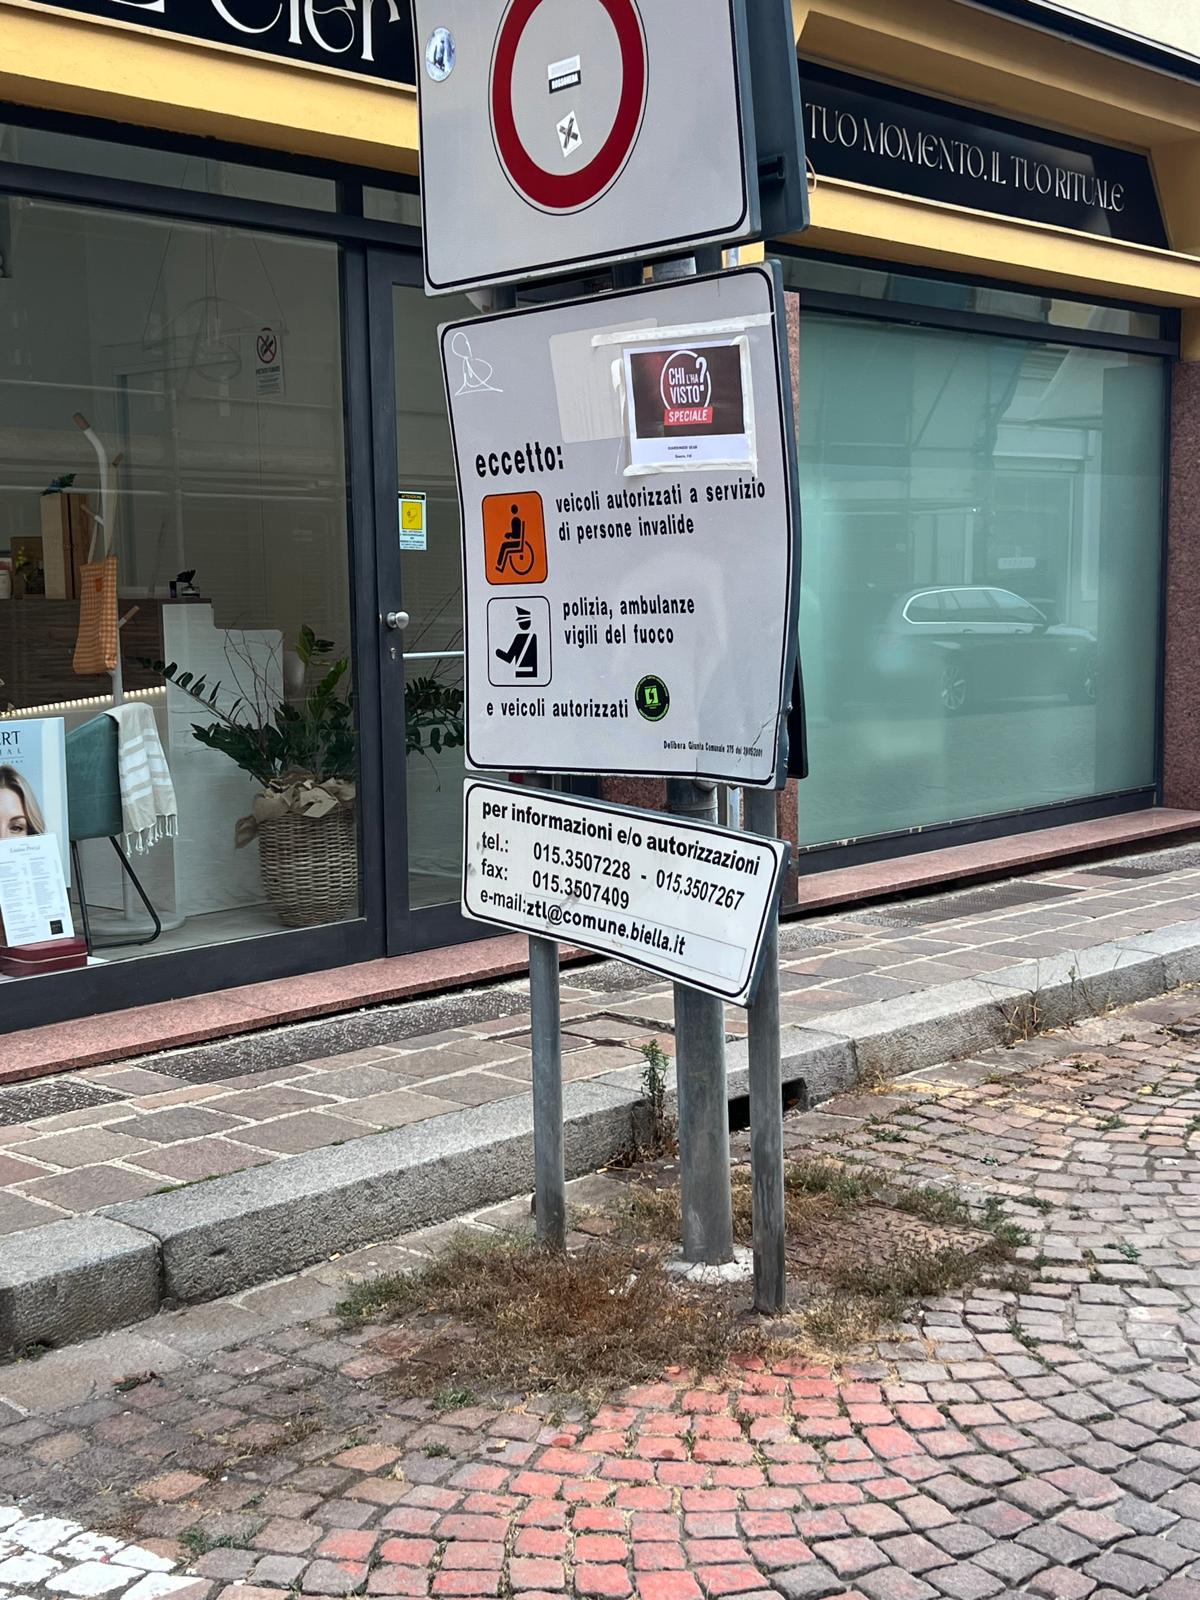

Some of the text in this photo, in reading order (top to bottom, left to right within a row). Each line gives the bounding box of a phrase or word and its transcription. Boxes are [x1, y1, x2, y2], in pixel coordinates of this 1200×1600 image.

[806, 103, 857, 147] TUO
[992, 151, 1006, 184] IL
[1010, 155, 1051, 194] TUO
[1055, 167, 1124, 212] RITUALE
[668, 367, 699, 385] CHI L'HA
[668, 409, 708, 422] SPECIALE
[475, 441, 564, 477] eccetto:
[556, 477, 766, 512] veicoli autorizzati a servizio
[558, 513, 694, 544] di persone invalide
[563, 595, 695, 620] polizia, ambulanze
[564, 623, 674, 649] vigili del fuoco
[486, 698, 629, 718] e veicoli autorizzati
[0, 730, 21, 746] RT
[663, 740, 686, 750] Delibera
[482, 801, 761, 876] per informazioni e/o autorizzazioni
[481, 858, 630, 909] fax: 015.3507409
[482, 832, 509, 853] tel.:
[533, 842, 631, 880] 015.3507228
[656, 869, 745, 911] 015.3507267
